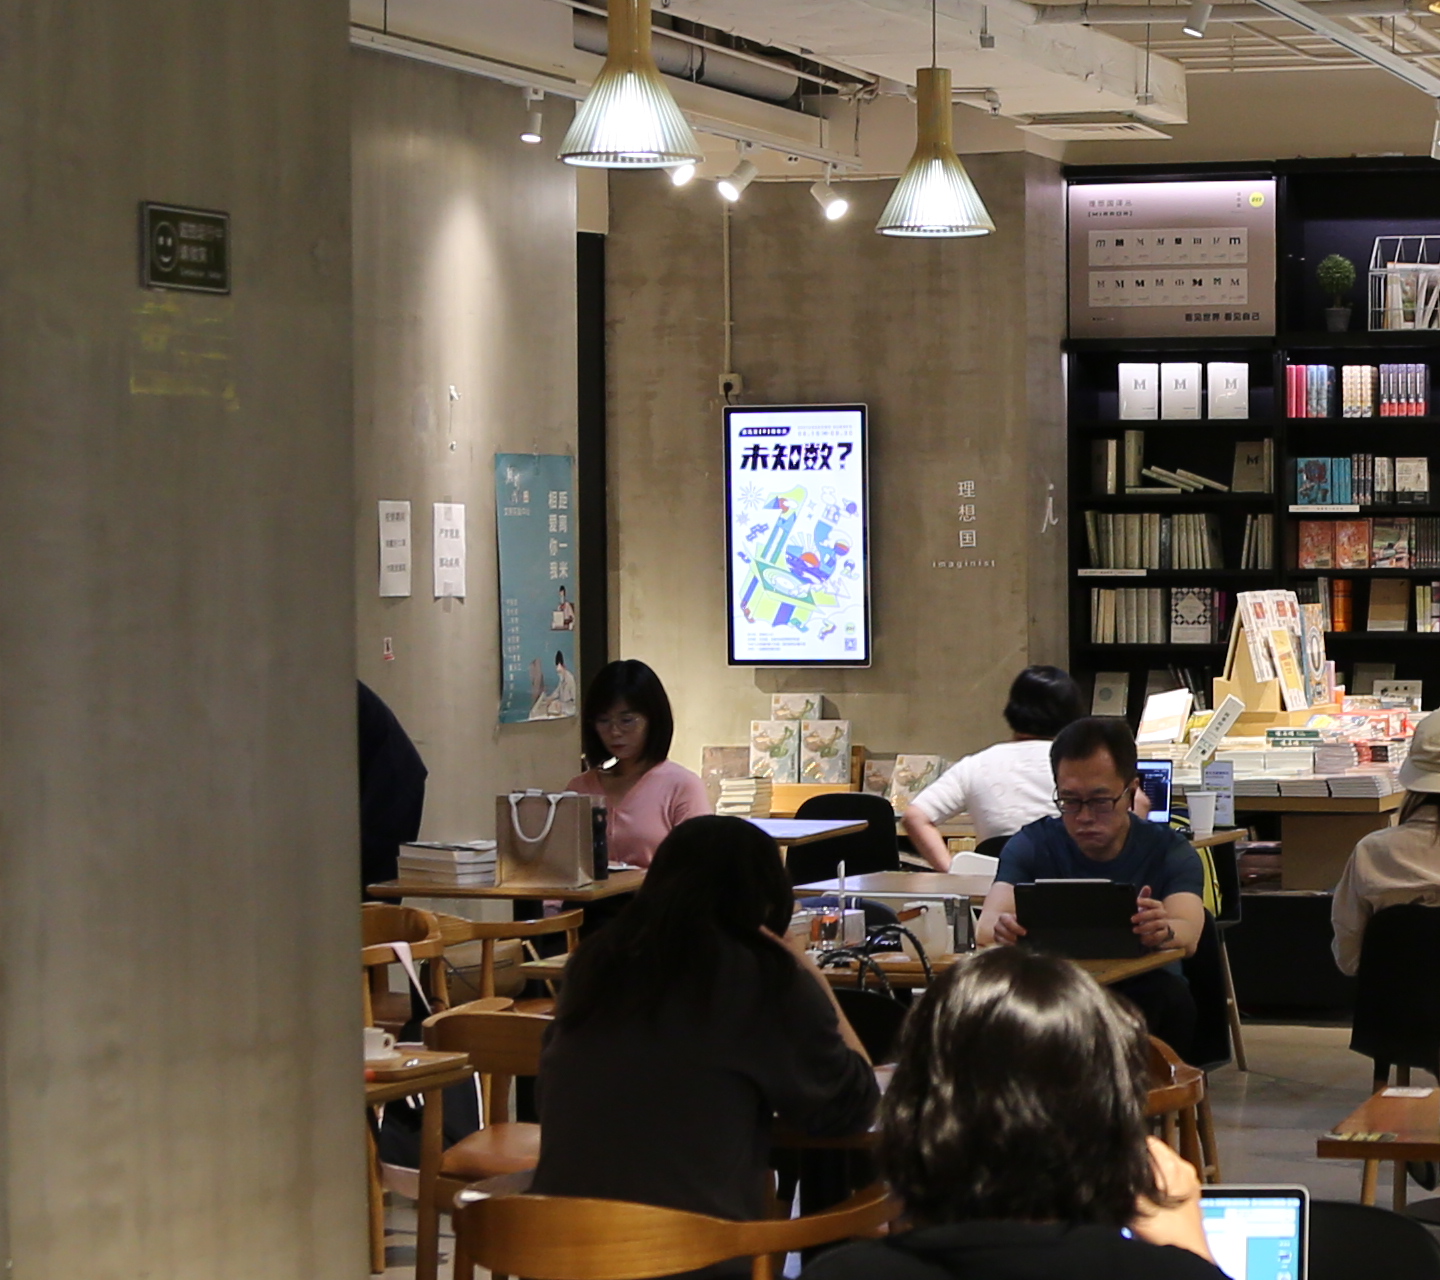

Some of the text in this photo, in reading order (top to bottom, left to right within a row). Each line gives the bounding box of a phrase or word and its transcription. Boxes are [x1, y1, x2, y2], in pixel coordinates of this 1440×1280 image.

[957, 480, 977, 548] 理想国
[933, 558, 996, 569] imaginist
